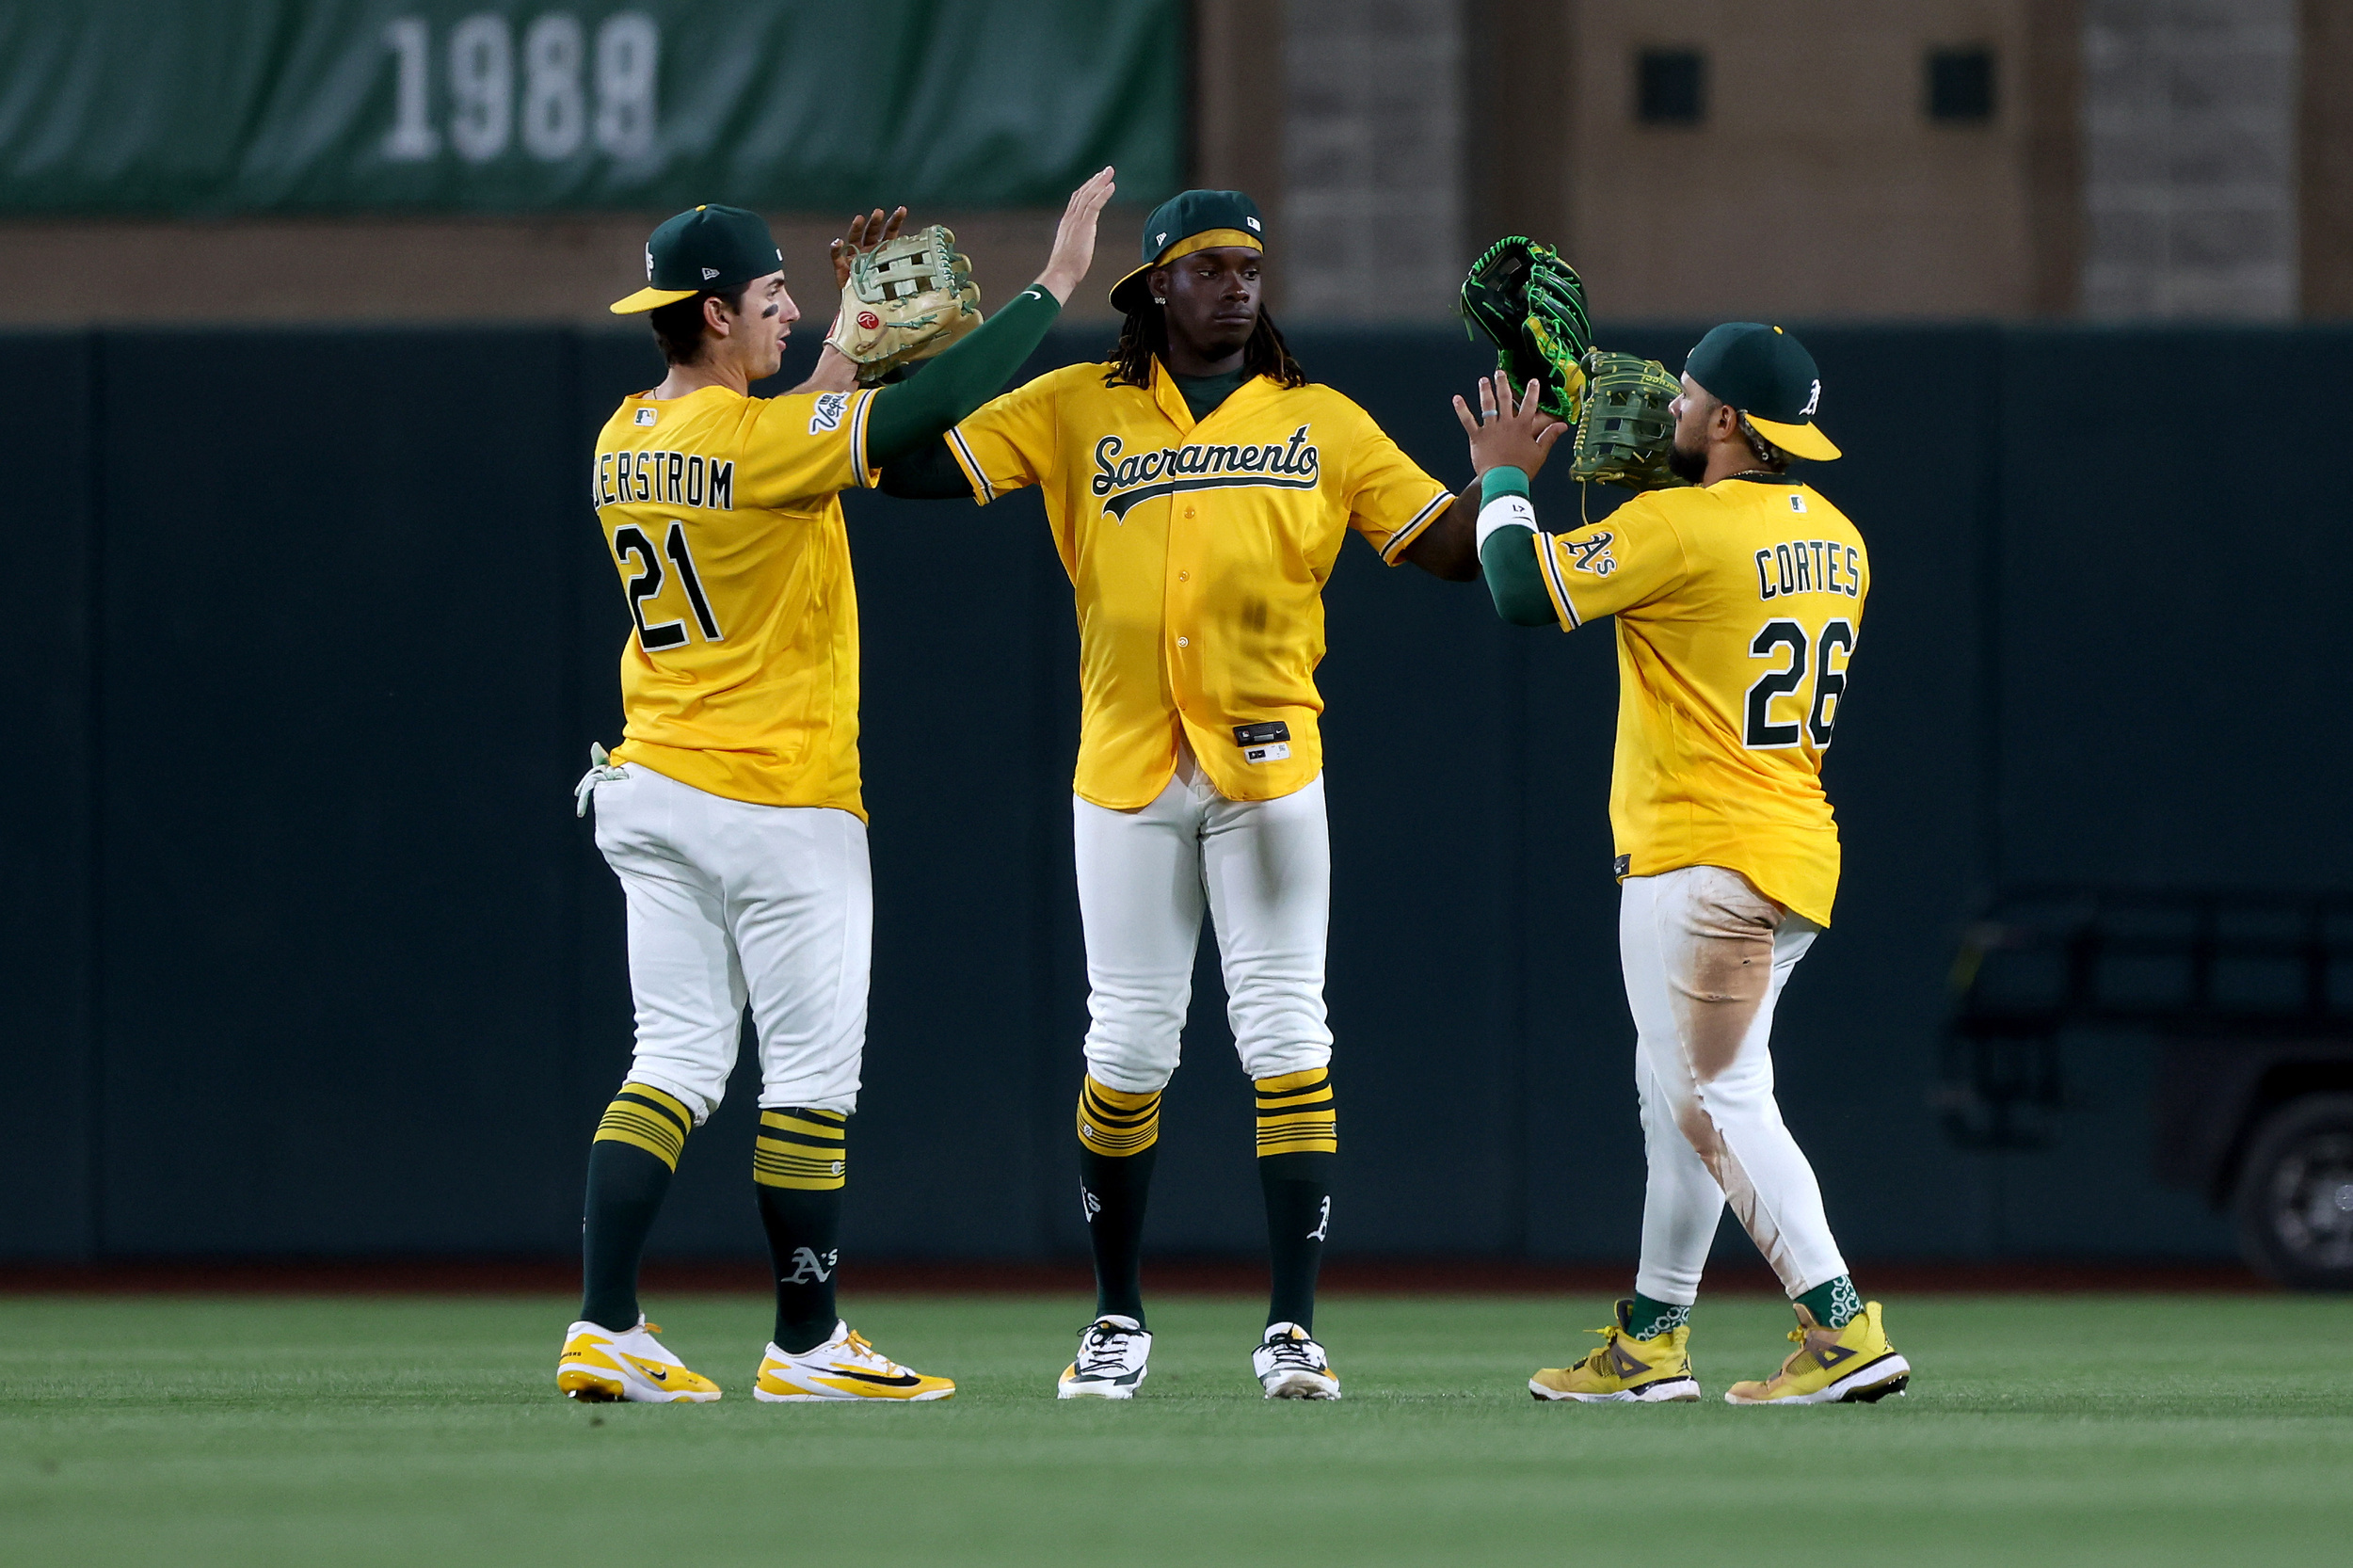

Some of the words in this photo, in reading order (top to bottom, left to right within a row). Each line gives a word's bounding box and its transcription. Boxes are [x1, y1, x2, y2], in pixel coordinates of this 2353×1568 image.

[1091, 423, 1319, 497] Sacramento
[614, 520, 725, 653] 21
[1559, 531, 1618, 579] A's
[1754, 538, 1860, 601] CORTES
[1742, 617, 1859, 750] 26
[780, 1246, 839, 1285] A's
